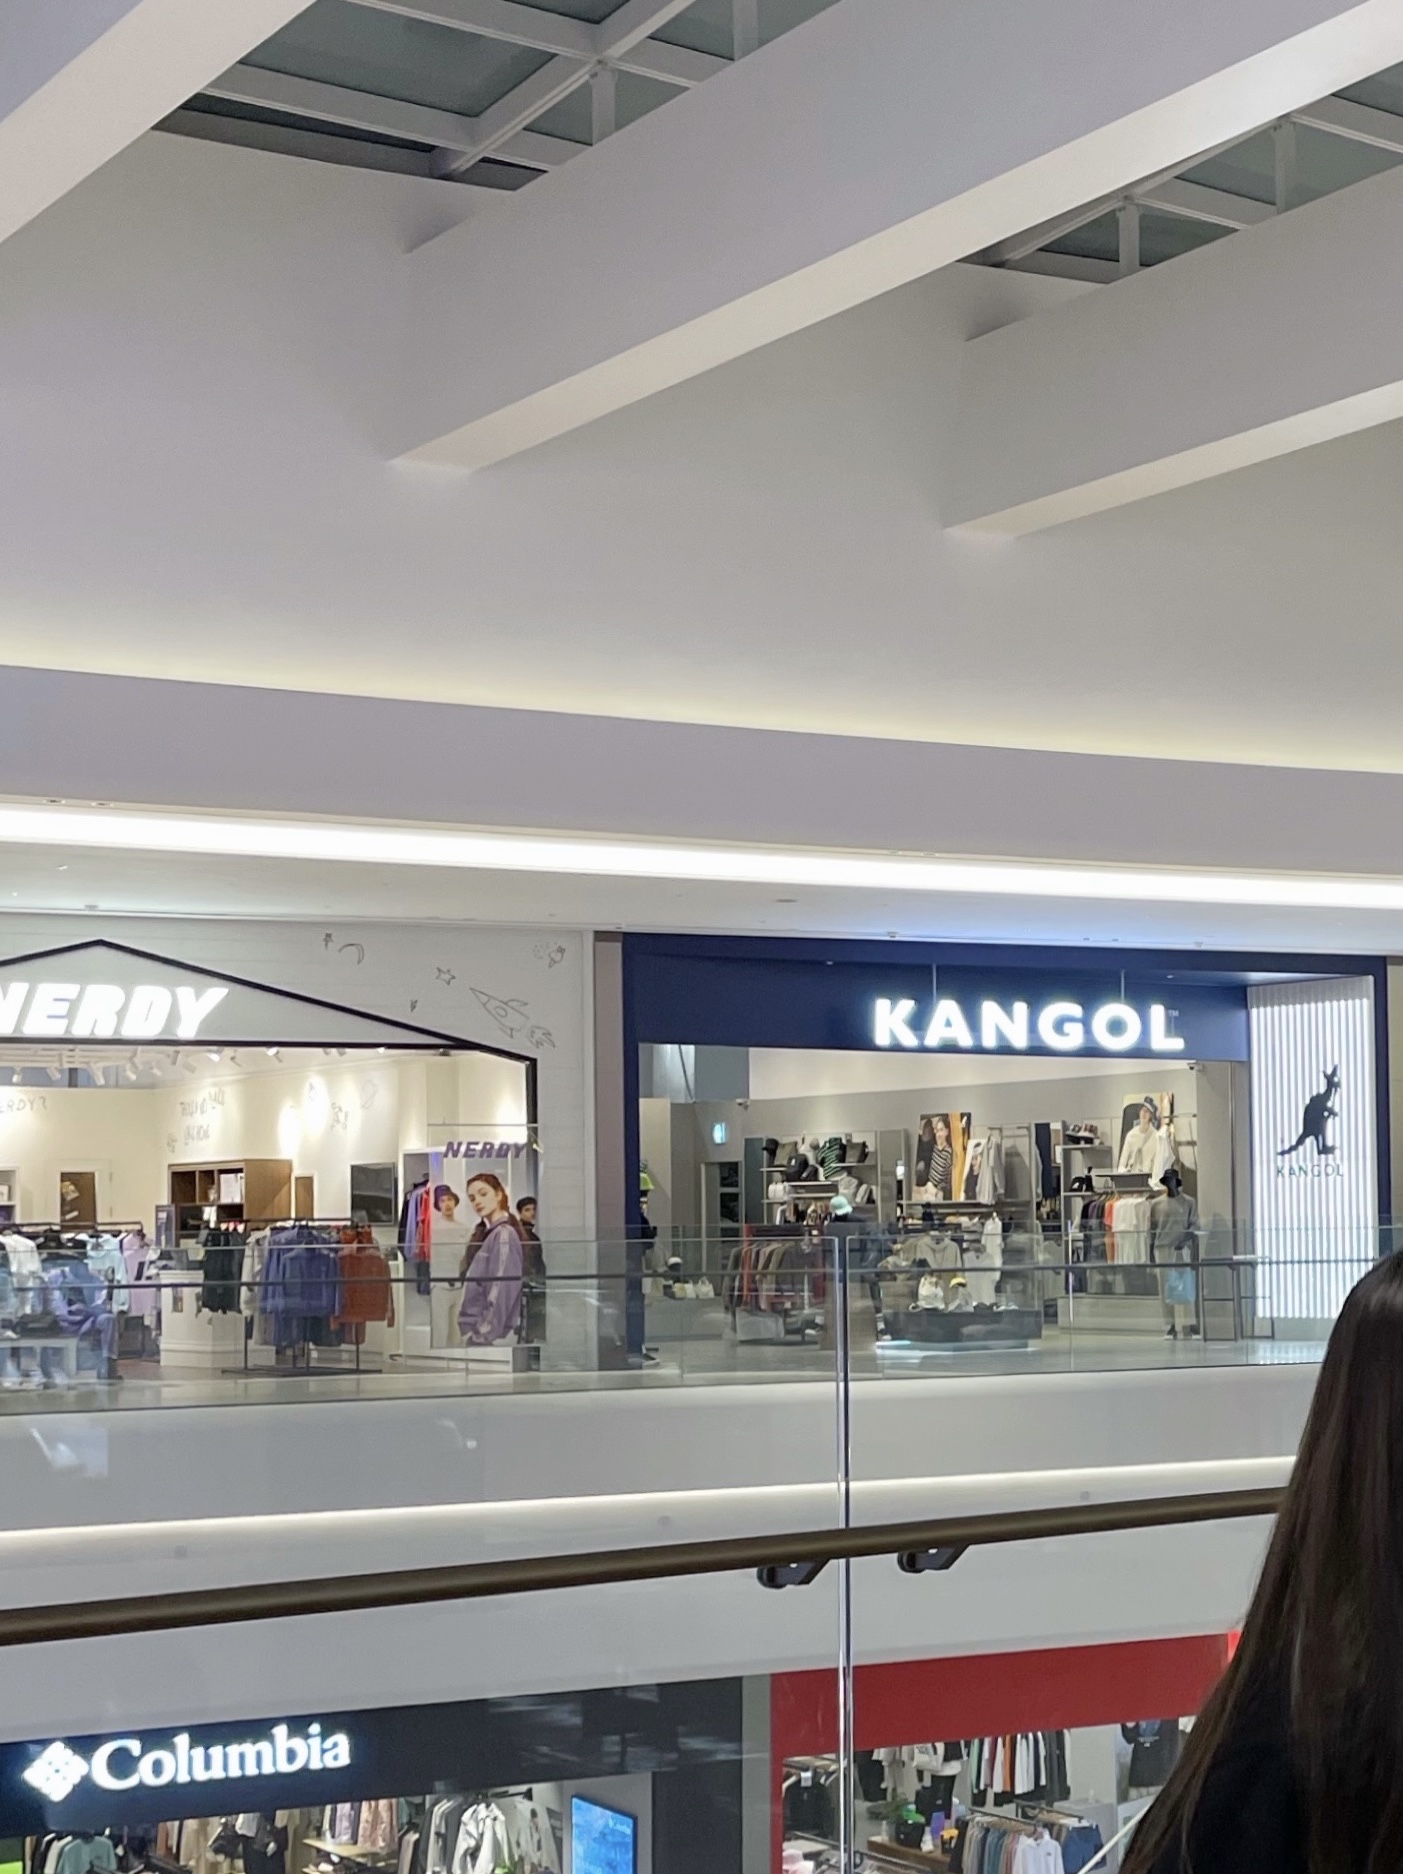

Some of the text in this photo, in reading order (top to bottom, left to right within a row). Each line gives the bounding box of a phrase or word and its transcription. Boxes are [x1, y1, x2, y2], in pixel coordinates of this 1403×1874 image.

[874, 998, 1185, 1051] KANGOL
[443, 1141, 526, 1159] NERDY
[1276, 1164, 1344, 1178] KANGOL
[91, 1722, 351, 1791] Columbia
